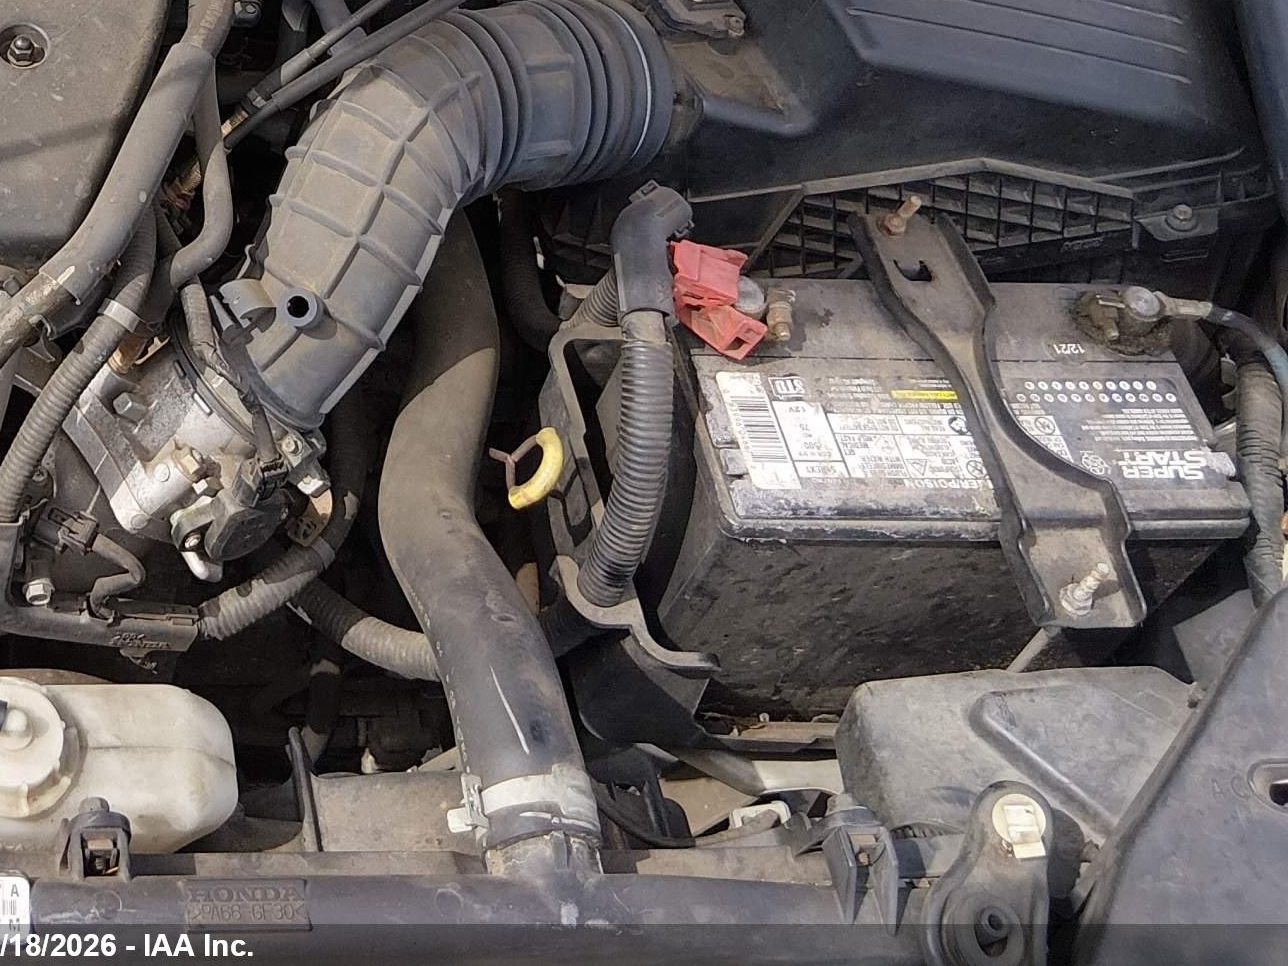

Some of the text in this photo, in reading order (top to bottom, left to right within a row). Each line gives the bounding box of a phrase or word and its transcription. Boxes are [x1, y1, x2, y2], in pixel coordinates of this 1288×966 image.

[1053, 343, 1086, 355] 12/21
[1117, 451, 1206, 466] START
[1122, 466, 1204, 480] SUPER
[10, 884, 20, 897] A
[188, 886, 305, 902] HONDA
